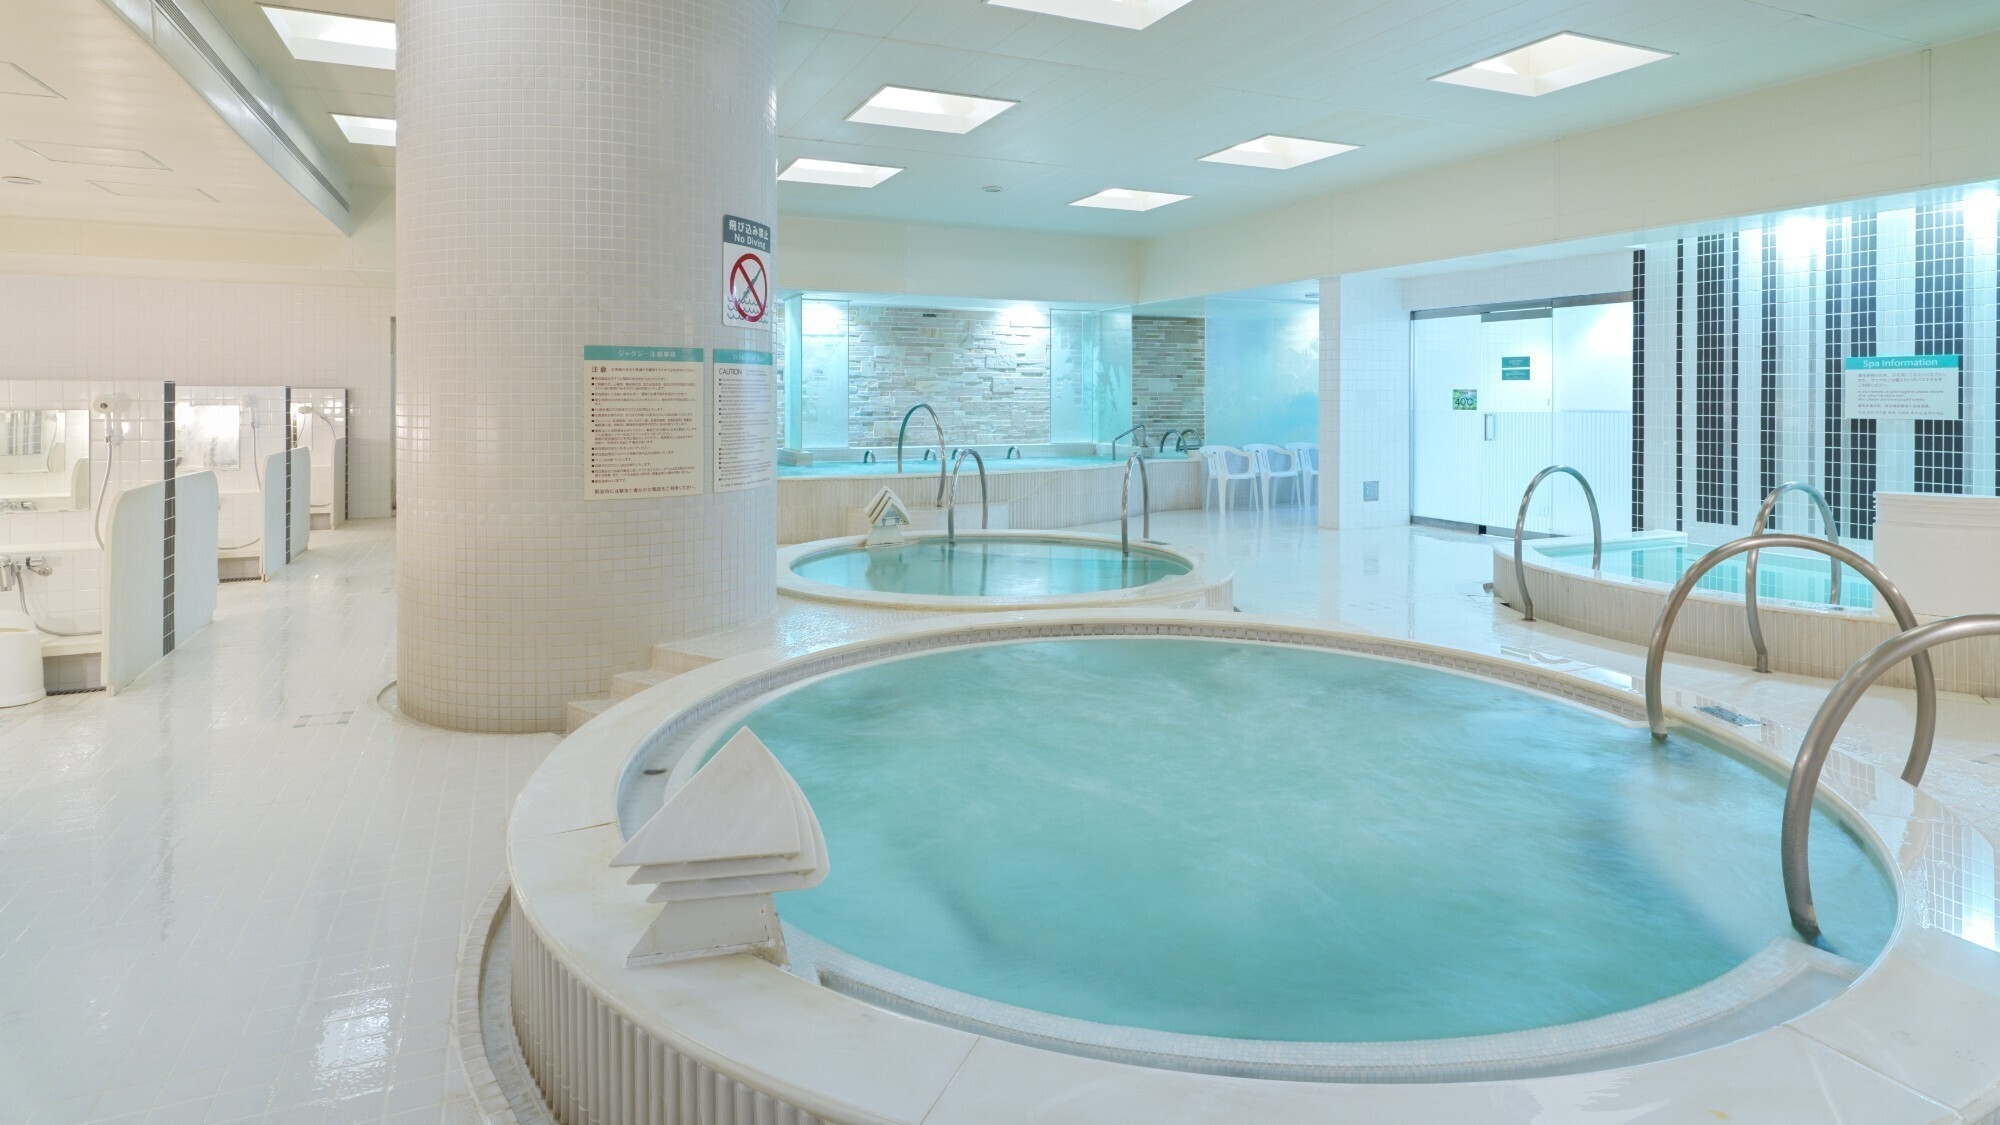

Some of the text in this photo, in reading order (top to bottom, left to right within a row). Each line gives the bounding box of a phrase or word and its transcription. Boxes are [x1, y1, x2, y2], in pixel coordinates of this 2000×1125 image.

[728, 219, 769, 241] 飛び込み禁止
[734, 232, 766, 250] No Diving
[1863, 359, 1938, 368] Spa Information
[718, 367, 743, 376] CAUTION
